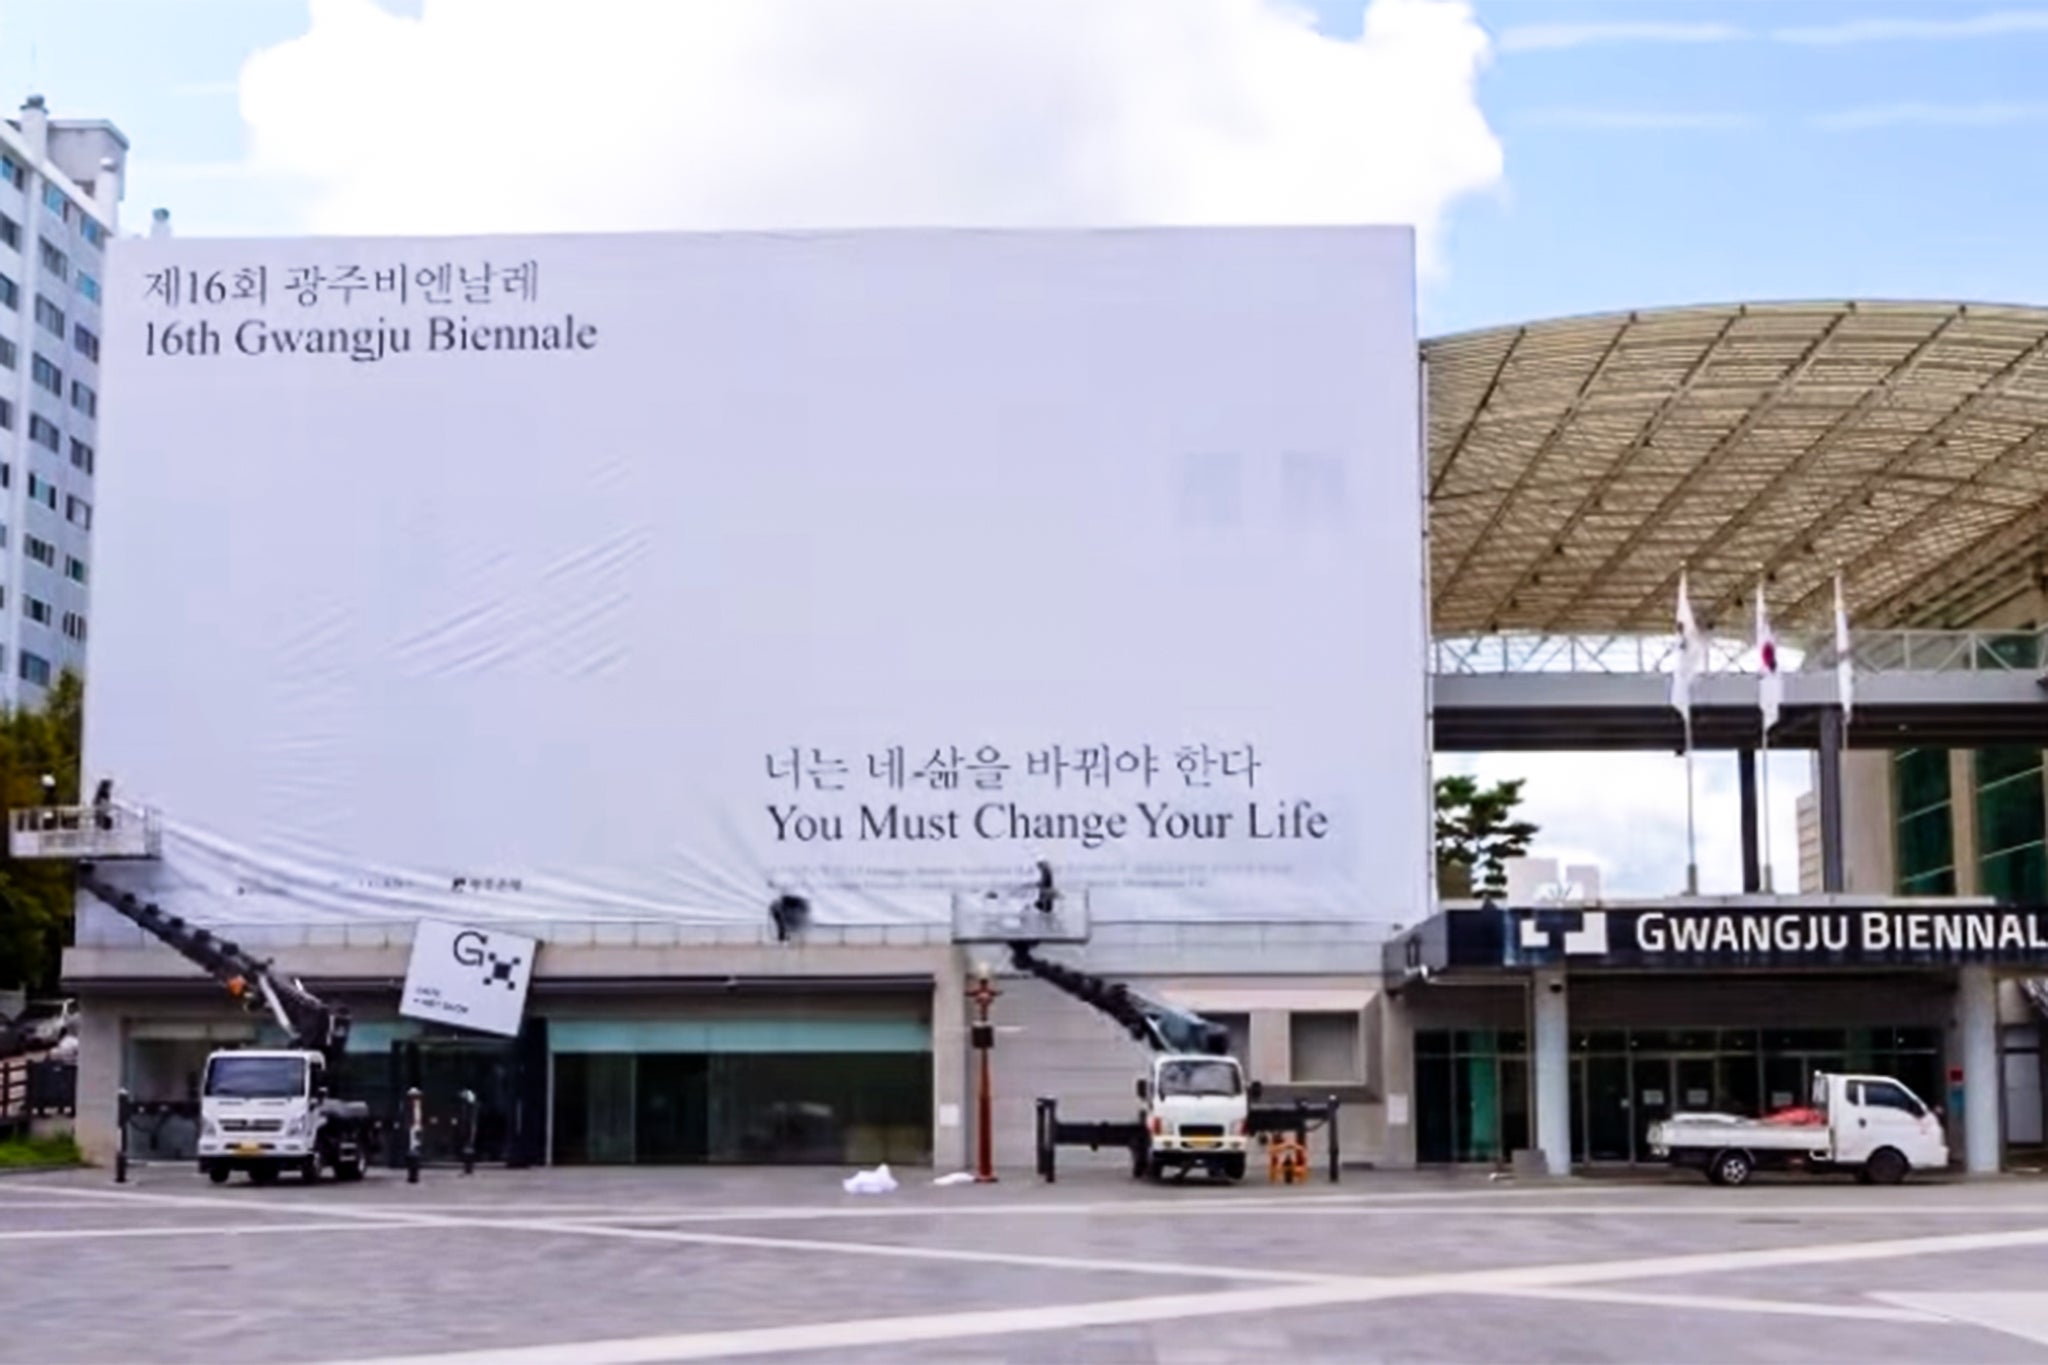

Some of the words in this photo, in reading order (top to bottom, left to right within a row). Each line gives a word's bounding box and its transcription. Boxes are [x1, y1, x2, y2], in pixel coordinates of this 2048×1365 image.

[143, 264, 267, 306] 제16회
[283, 260, 538, 307] 광주비엔날레
[145, 320, 221, 357] 16th
[234, 317, 411, 363] Gwangju
[427, 314, 599, 352] Biennale
[765, 746, 849, 791] 너는
[867, 745, 905, 790] 네
[912, 745, 1012, 791] 삶을
[1026, 743, 1161, 789] 바꿔야
[1175, 743, 1263, 789] 한다
[766, 804, 844, 842] You
[859, 803, 959, 842] Must
[973, 801, 1128, 850] Change
[1136, 801, 1234, 841] Your
[1248, 800, 1330, 841] Life
